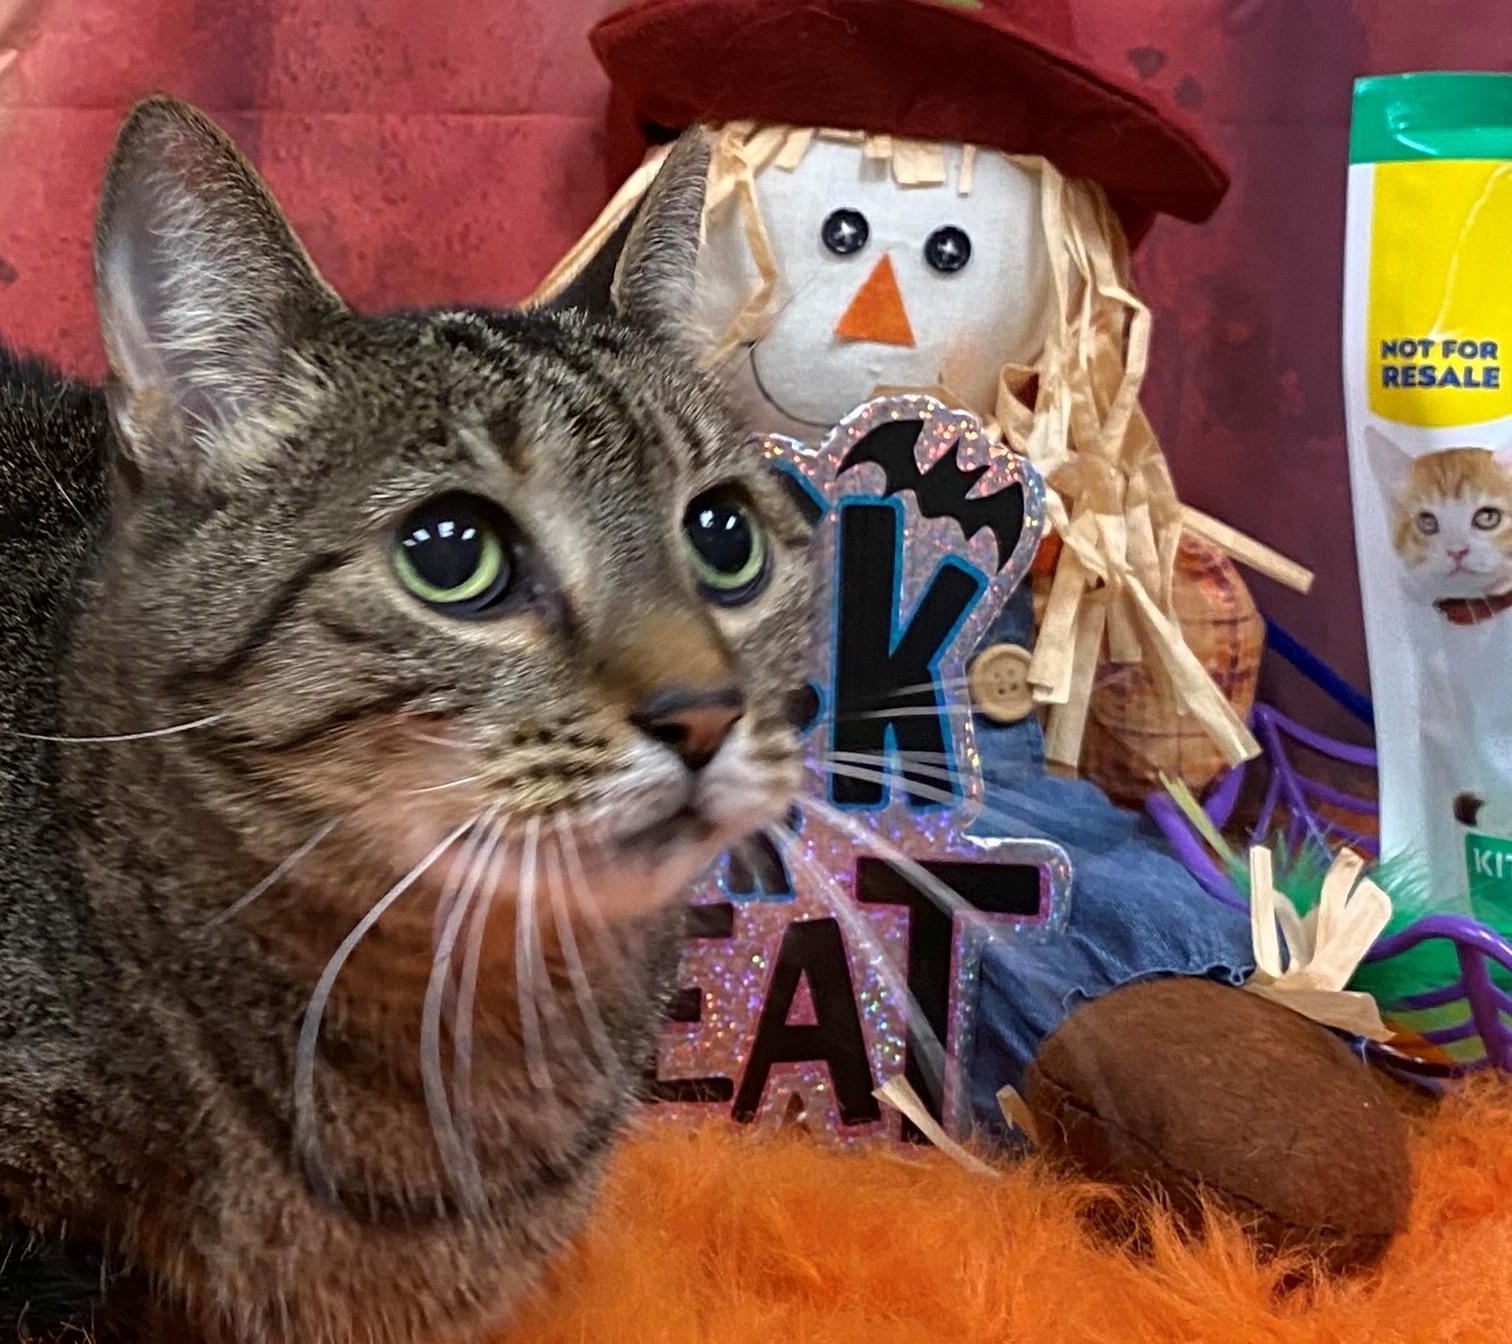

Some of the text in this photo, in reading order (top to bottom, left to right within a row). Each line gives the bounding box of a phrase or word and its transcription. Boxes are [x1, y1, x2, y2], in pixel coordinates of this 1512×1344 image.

[1381, 338, 1498, 360] NOT FOR
[1382, 364, 1501, 389] RESALE
[772, 459, 988, 813] K
